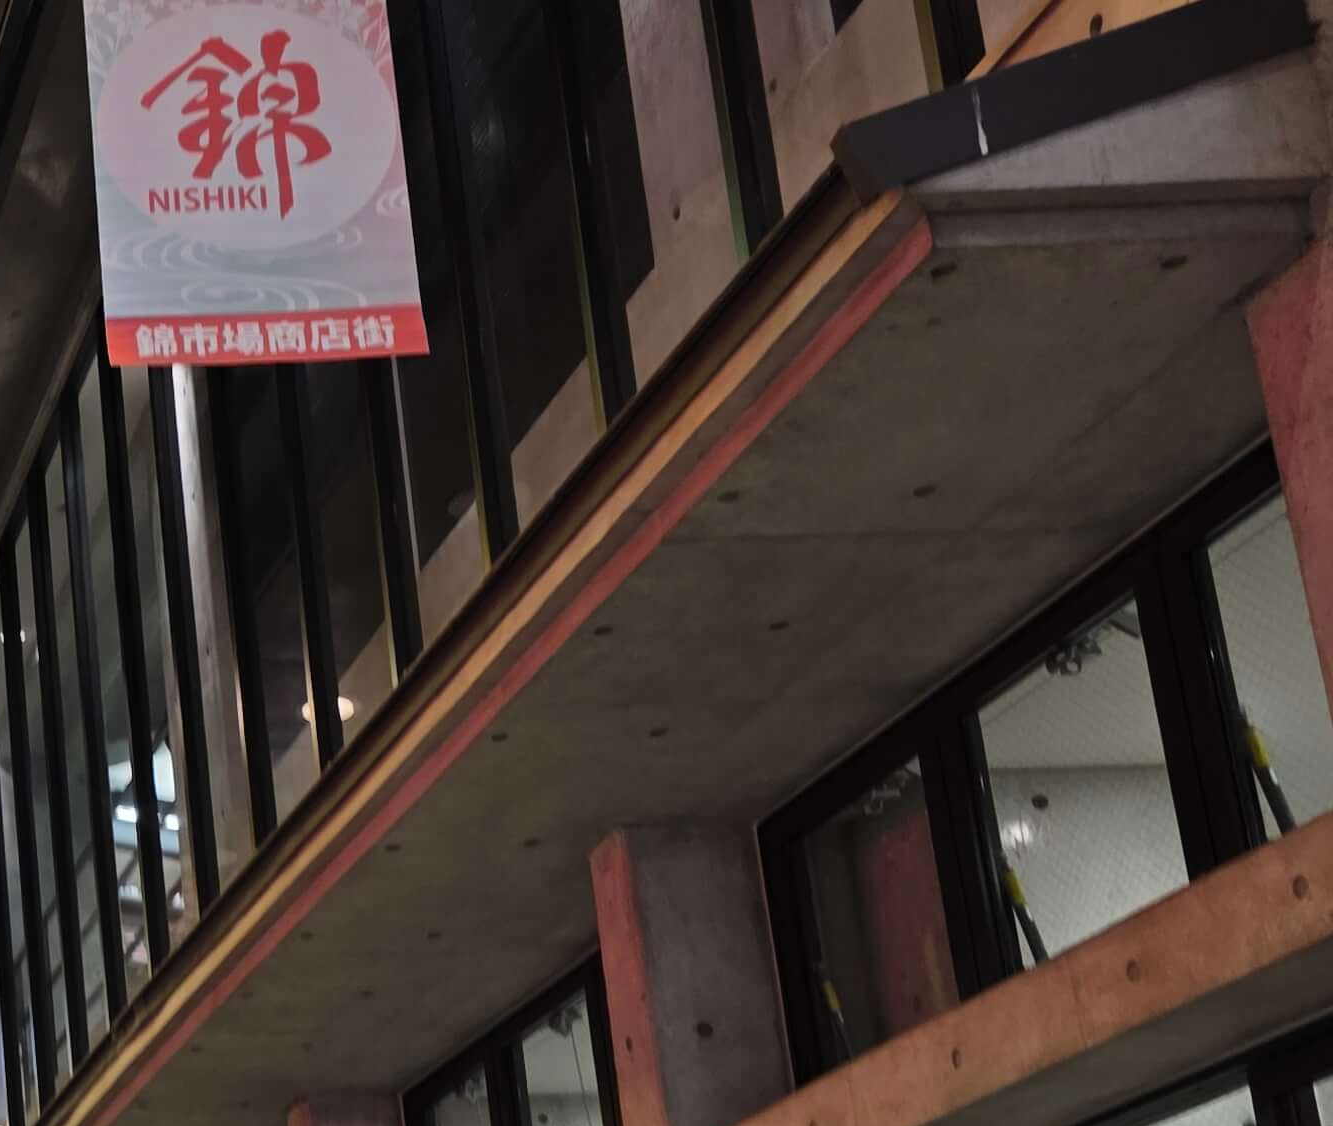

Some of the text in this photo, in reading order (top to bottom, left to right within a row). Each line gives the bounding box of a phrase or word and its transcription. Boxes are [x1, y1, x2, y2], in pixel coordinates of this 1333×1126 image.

[139, 29, 333, 221] 錦
[147, 186, 268, 214] NISHIKI
[134, 314, 396, 359] 錦市場商店街
